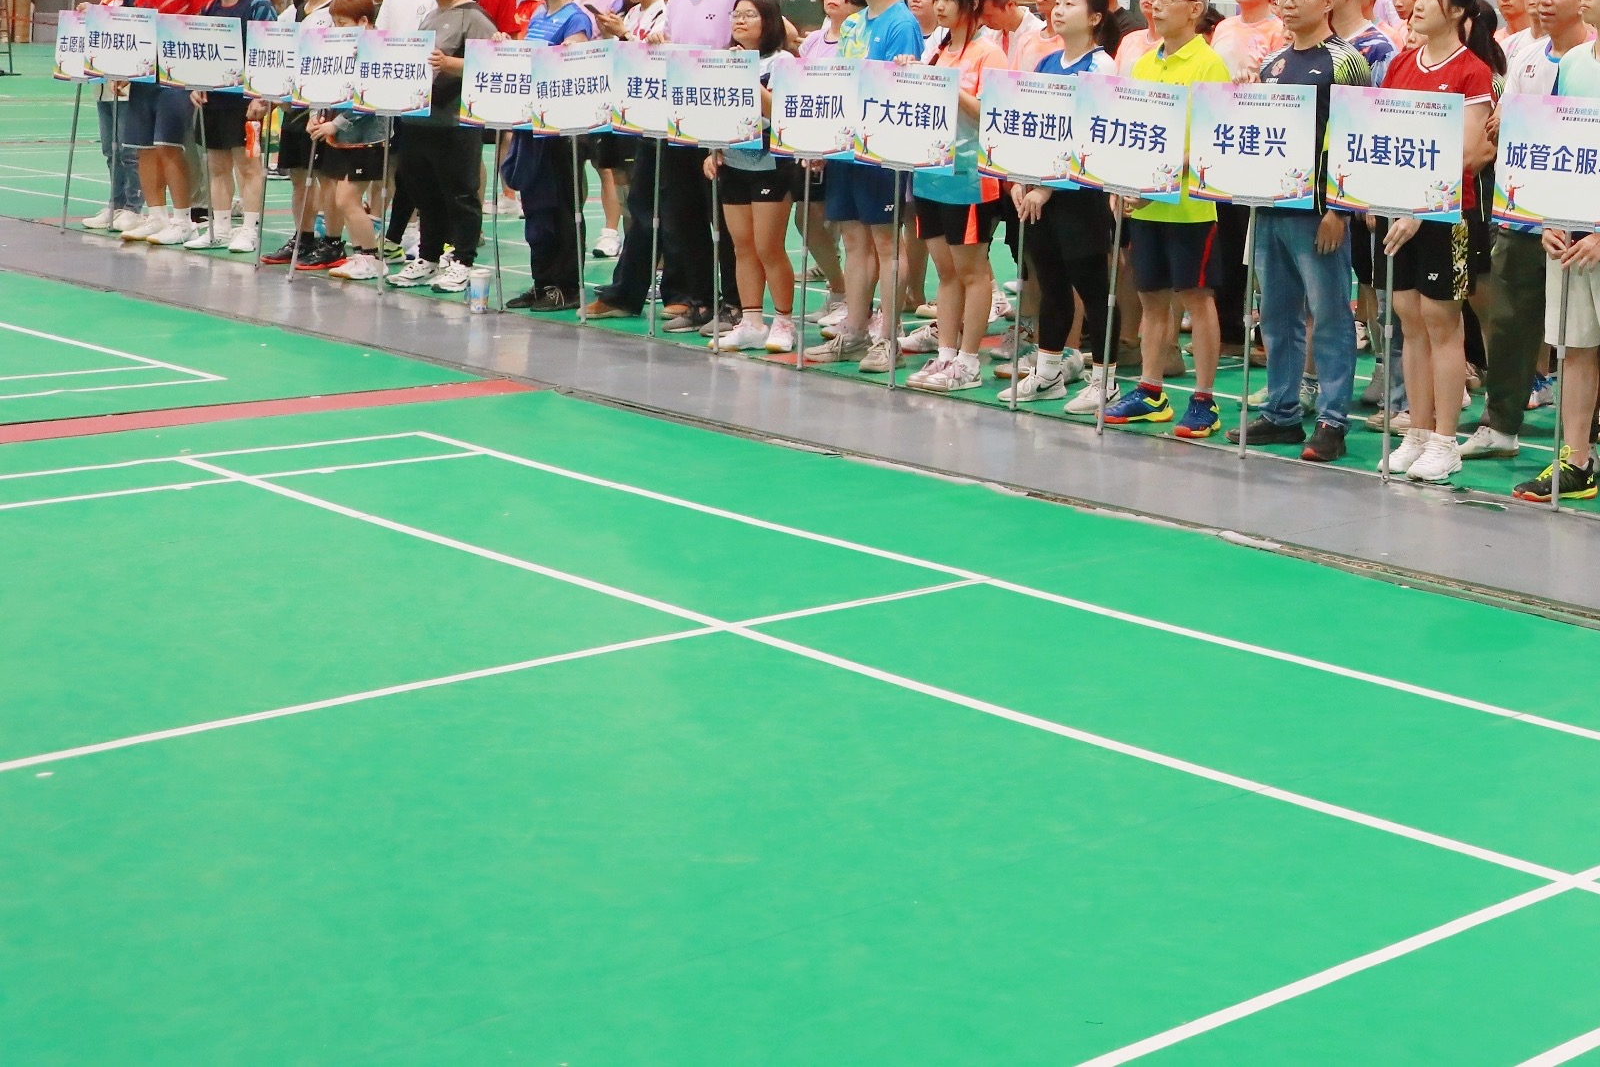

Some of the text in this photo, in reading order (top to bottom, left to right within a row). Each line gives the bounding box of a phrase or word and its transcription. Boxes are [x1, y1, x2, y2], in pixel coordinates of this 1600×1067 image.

[88, 30, 152, 52] 建协联队一
[162, 40, 238, 62] 建协联队二
[248, 48, 295, 69] 建协联队三
[300, 56, 356, 76] 建协联队四
[359, 61, 427, 81] 番电荣安联队
[475, 71, 532, 96] 华誉品智
[536, 74, 611, 100] 镇街建设联队
[671, 86, 755, 108] 番禺区税务局
[784, 94, 846, 120] 番盈新队
[861, 97, 949, 132] 广大先锋队
[985, 106, 1074, 142] 大建奋进队
[1089, 115, 1168, 154] 有力劳务
[1212, 123, 1288, 159] 华建兴
[1346, 133, 1441, 172] 弘基设计
